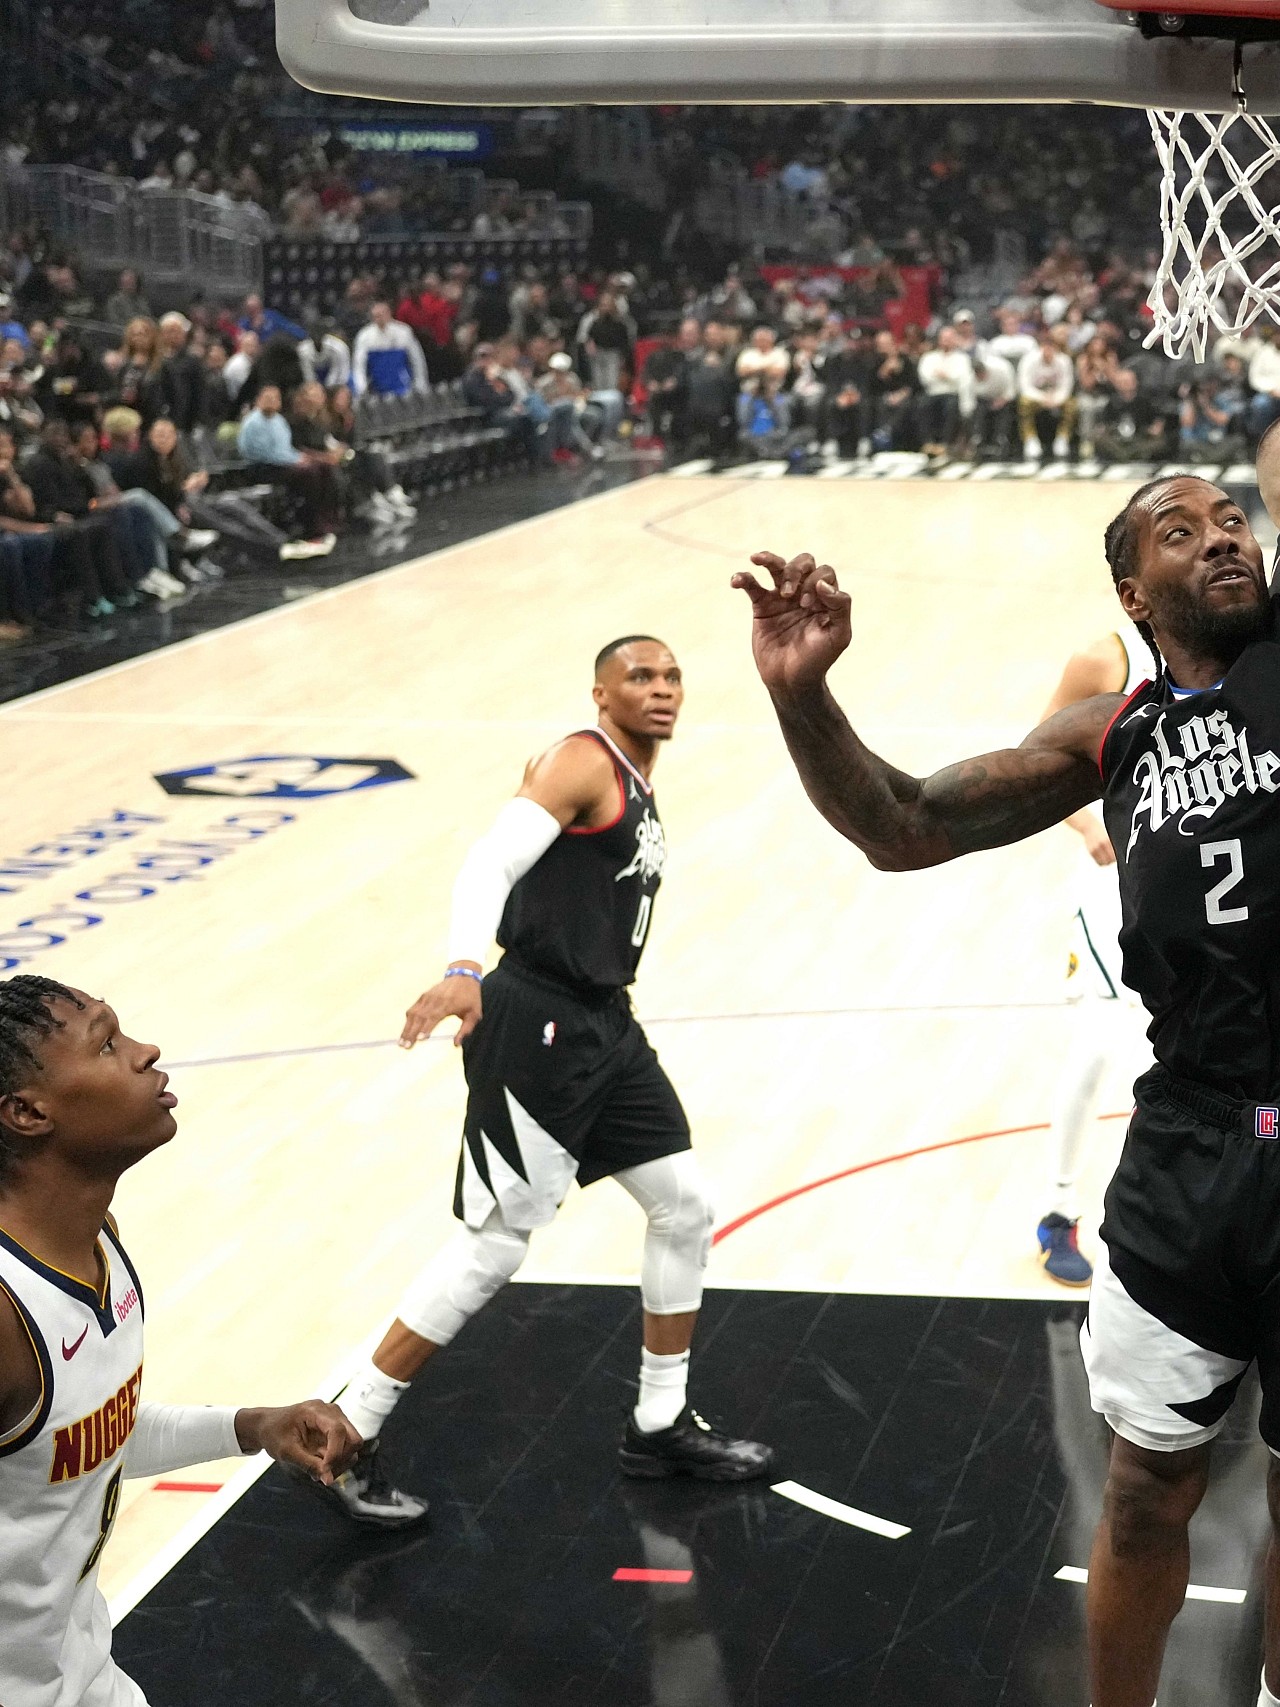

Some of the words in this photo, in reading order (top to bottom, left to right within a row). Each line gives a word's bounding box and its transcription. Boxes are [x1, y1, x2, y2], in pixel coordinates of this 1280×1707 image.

[1151, 709, 1237, 774] Los
[1200, 838, 1249, 925] 2
[631, 894, 651, 948] 0
[114, 1288, 138, 1323] ibotta
[48, 1361, 143, 1485] NUGGE
